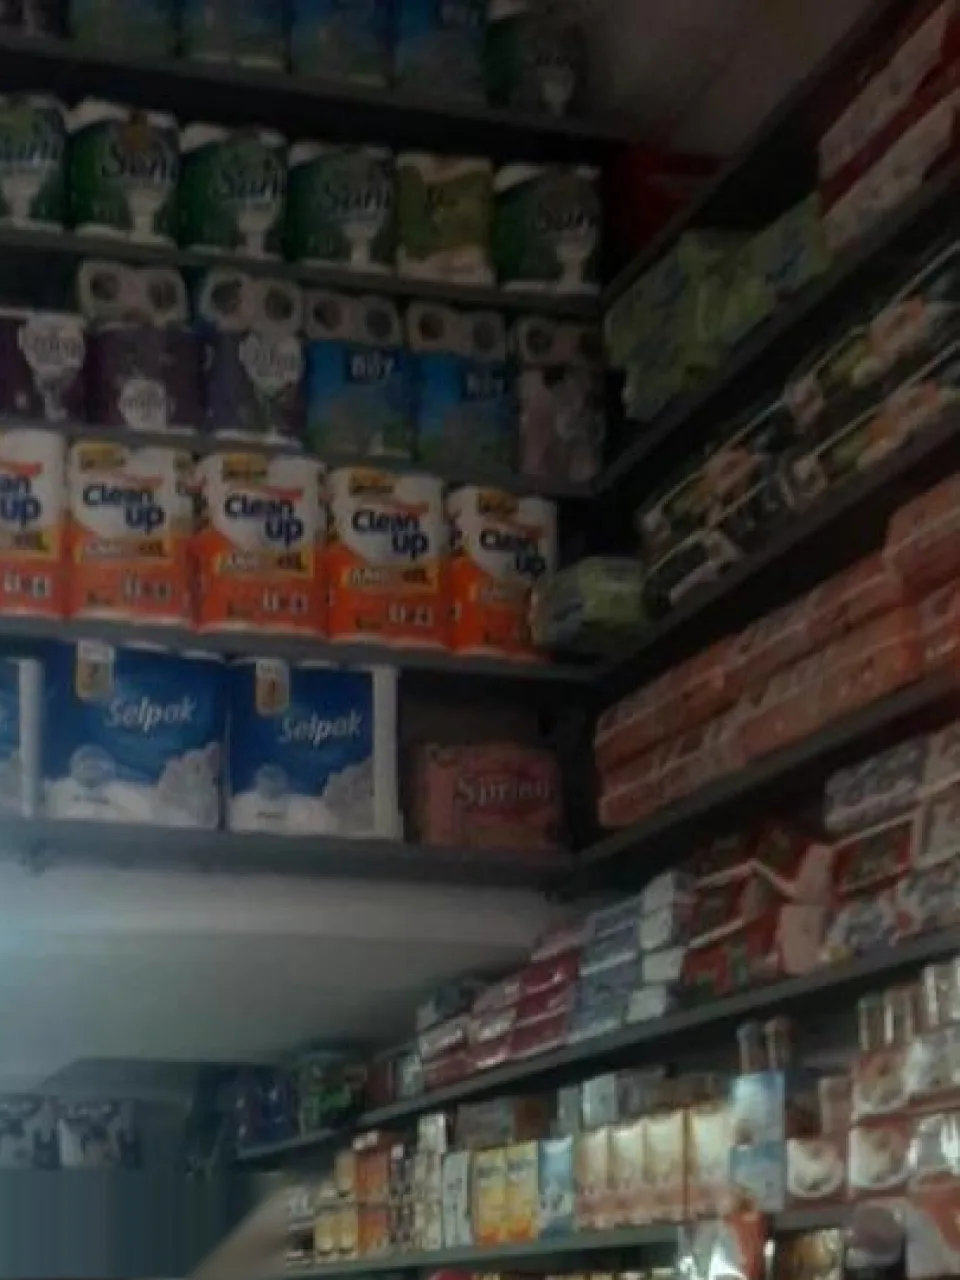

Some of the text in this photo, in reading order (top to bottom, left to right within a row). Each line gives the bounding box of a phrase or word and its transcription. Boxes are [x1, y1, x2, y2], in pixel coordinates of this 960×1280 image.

[82, 484, 155, 508] Clean
[224, 494, 297, 518] Clean
[352, 510, 421, 534] Clean
[479, 529, 540, 553] Clean
[104, 696, 198, 733] Selpak
[277, 708, 364, 747] Selpak
